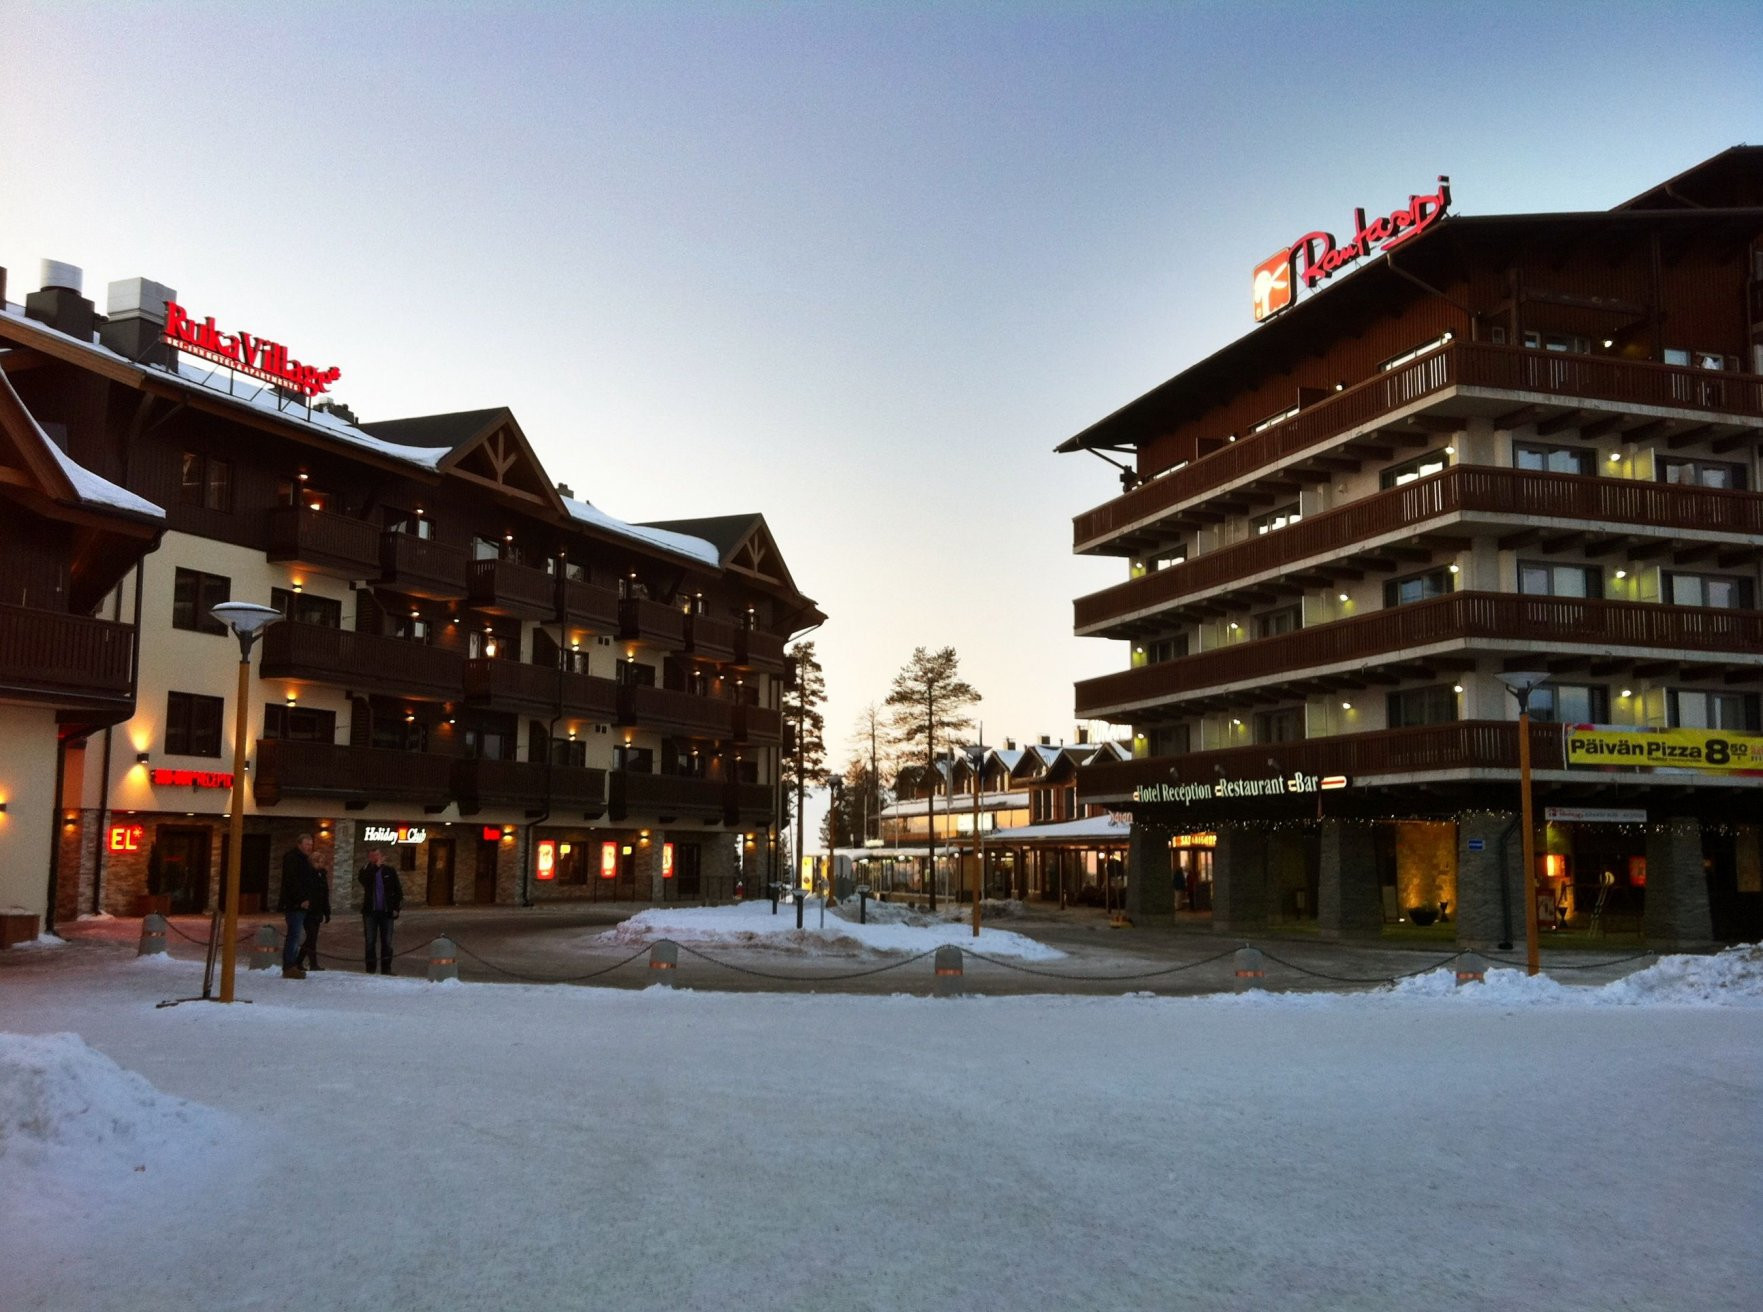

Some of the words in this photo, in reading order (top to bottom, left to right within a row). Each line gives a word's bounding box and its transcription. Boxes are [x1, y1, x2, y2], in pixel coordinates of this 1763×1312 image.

[165, 337, 205, 357] SKI-INN
[206, 351, 236, 370] HOTEL
[244, 364, 299, 391] APARTMENTS
[1571, 738, 1644, 756] Päivän
[1647, 741, 1702, 758] Pizza
[1136, 783, 1161, 803] Hotel
[1163, 781, 1212, 806] Reception
[1220, 775, 1285, 798] Restaurant
[1295, 771, 1319, 793] Bar
[364, 826, 398, 845] Holiday
[407, 827, 427, 842] Club
